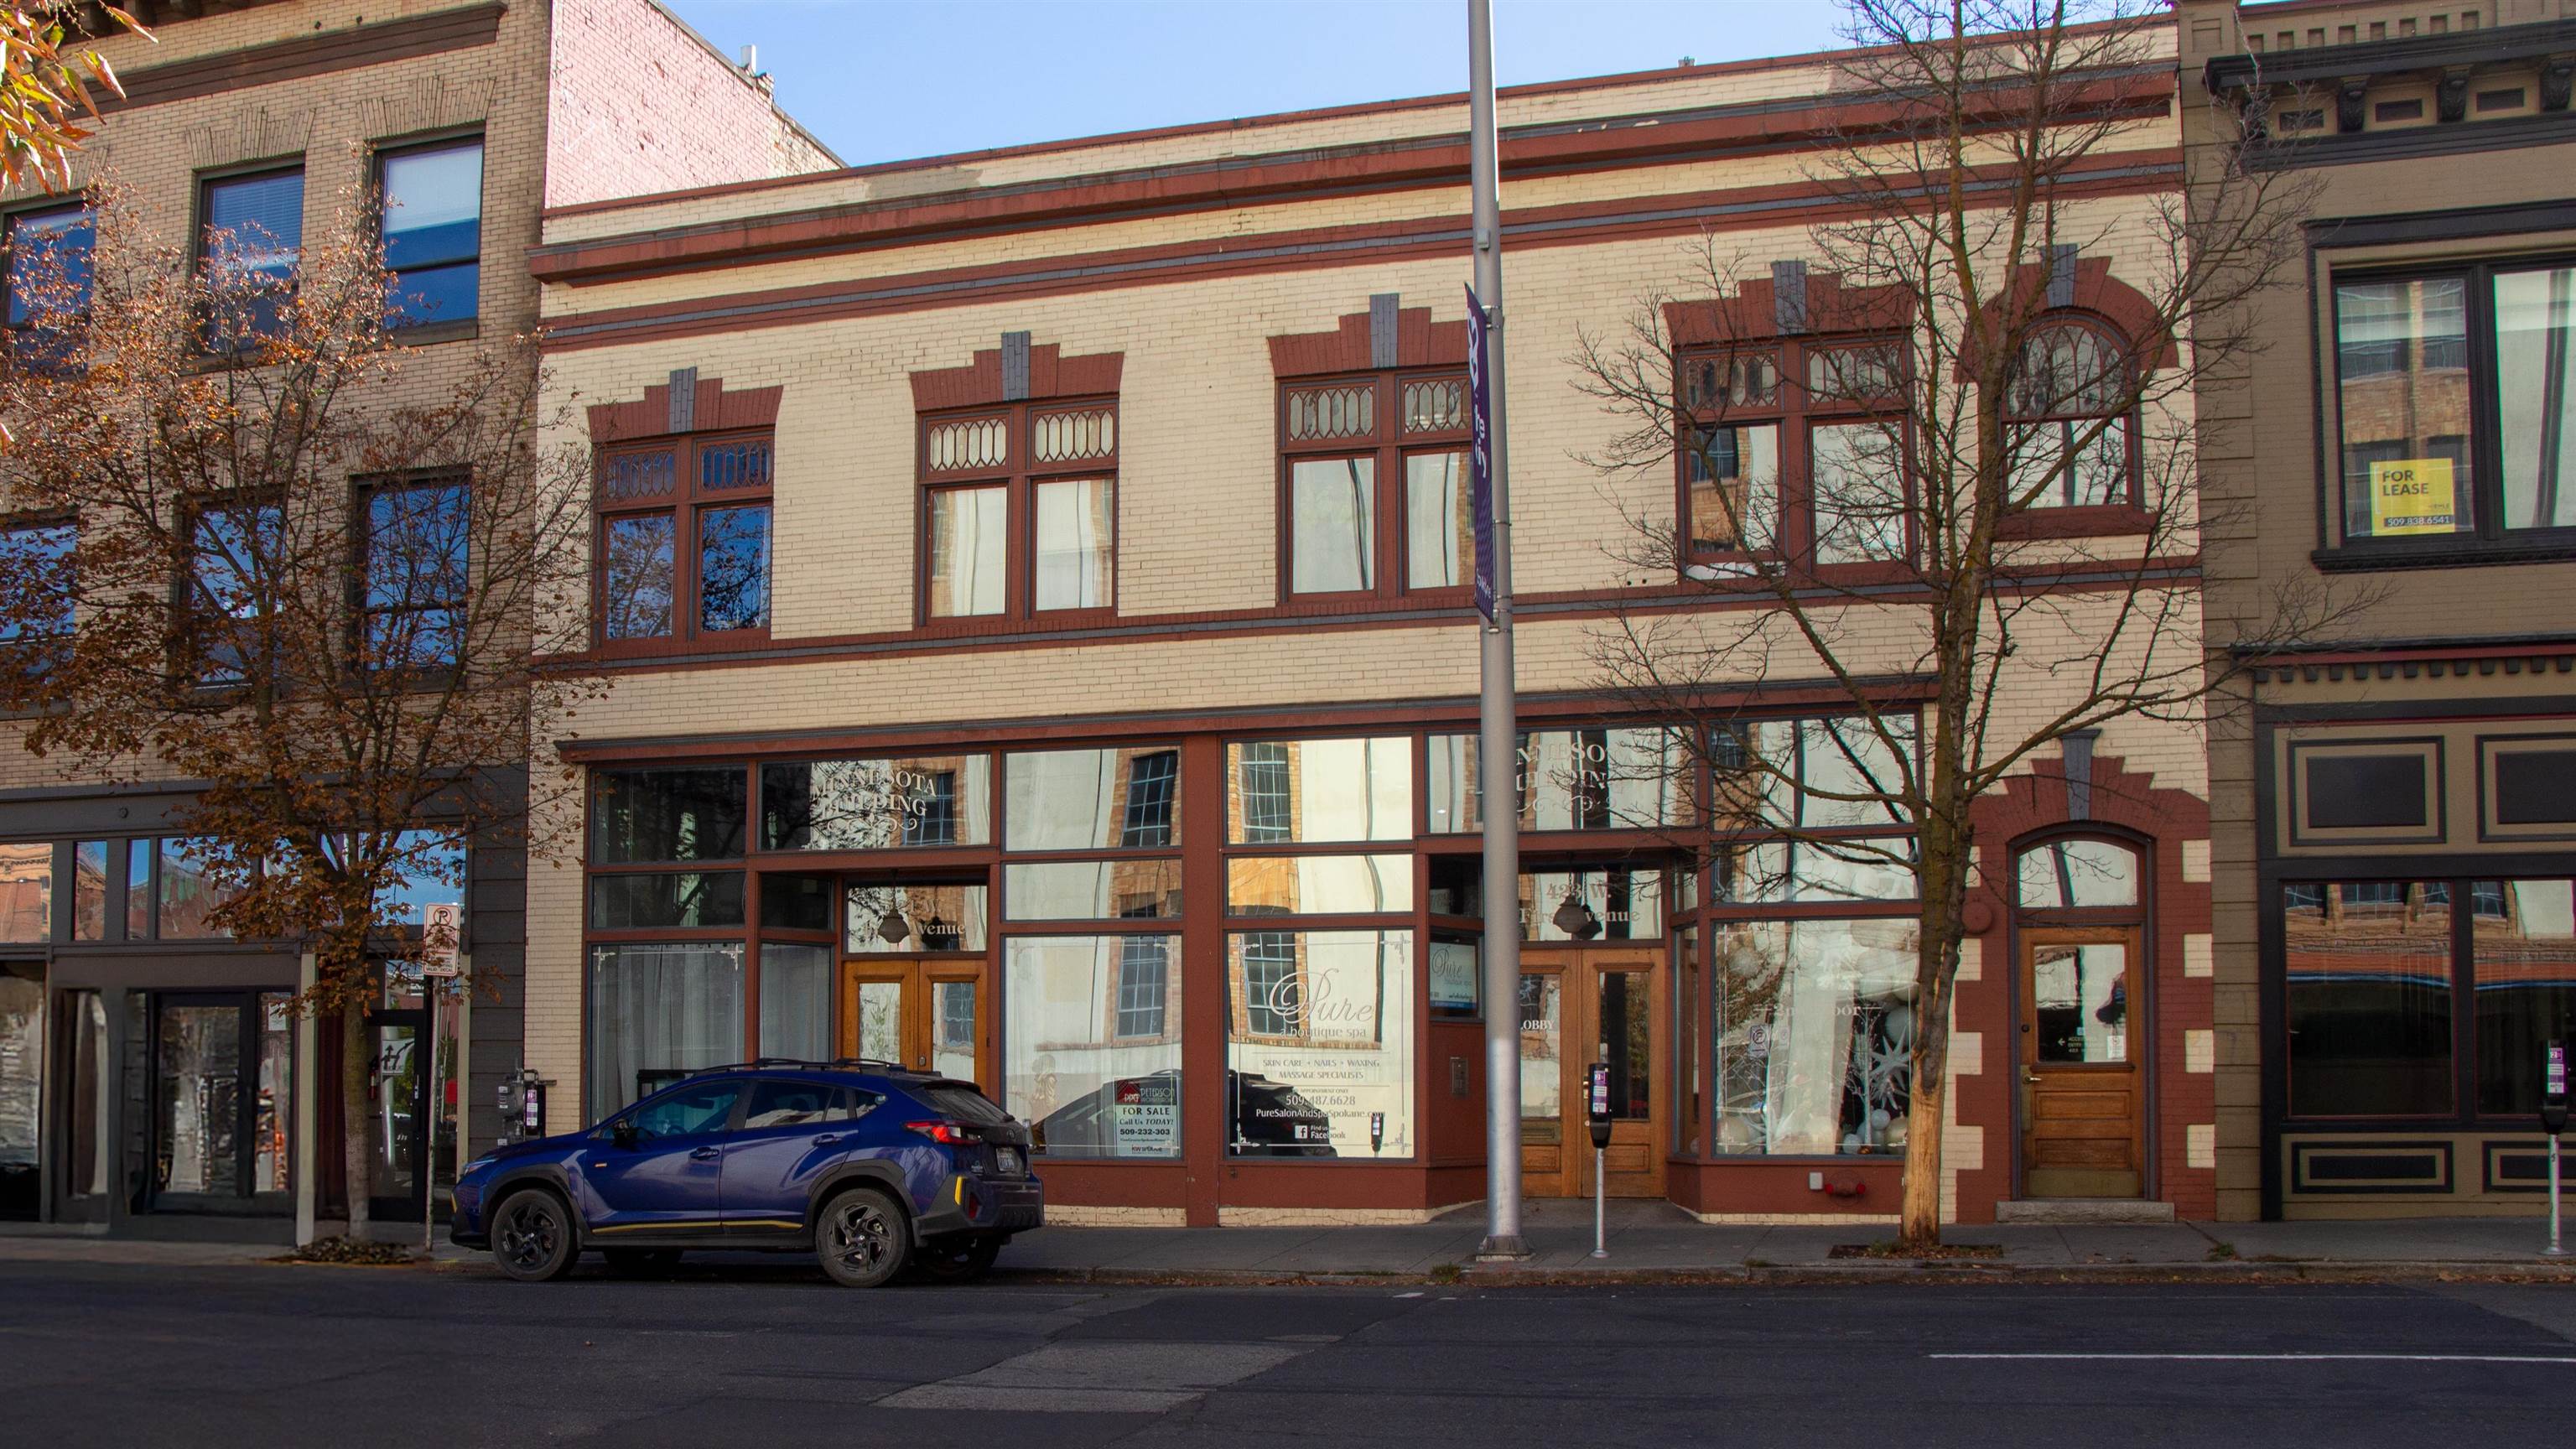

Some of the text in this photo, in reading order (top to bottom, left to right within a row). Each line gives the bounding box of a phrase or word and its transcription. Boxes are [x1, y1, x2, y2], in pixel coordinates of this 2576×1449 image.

[2382, 470, 2413, 482] FOR
[2382, 483, 2428, 496] LEASE
[2387, 516, 2450, 527] 509.838.6541
[812, 768, 937, 799] MINNESOTA
[1589, 882, 1612, 900] W.
[1585, 911, 1640, 922] venue
[1431, 944, 1462, 978] Pure
[1269, 968, 1374, 1025] Pure
[1520, 1019, 1554, 1031] OBBY
[1280, 1026, 1366, 1037] a boutique spa
[1348, 1059, 1380, 1067] WAXING
[1285, 1094, 1356, 1106] 509.487.6628
[1123, 1107, 1171, 1115] FOR SALE
[1255, 1109, 1386, 1121] PureSalonAndSpaSpokane.com
